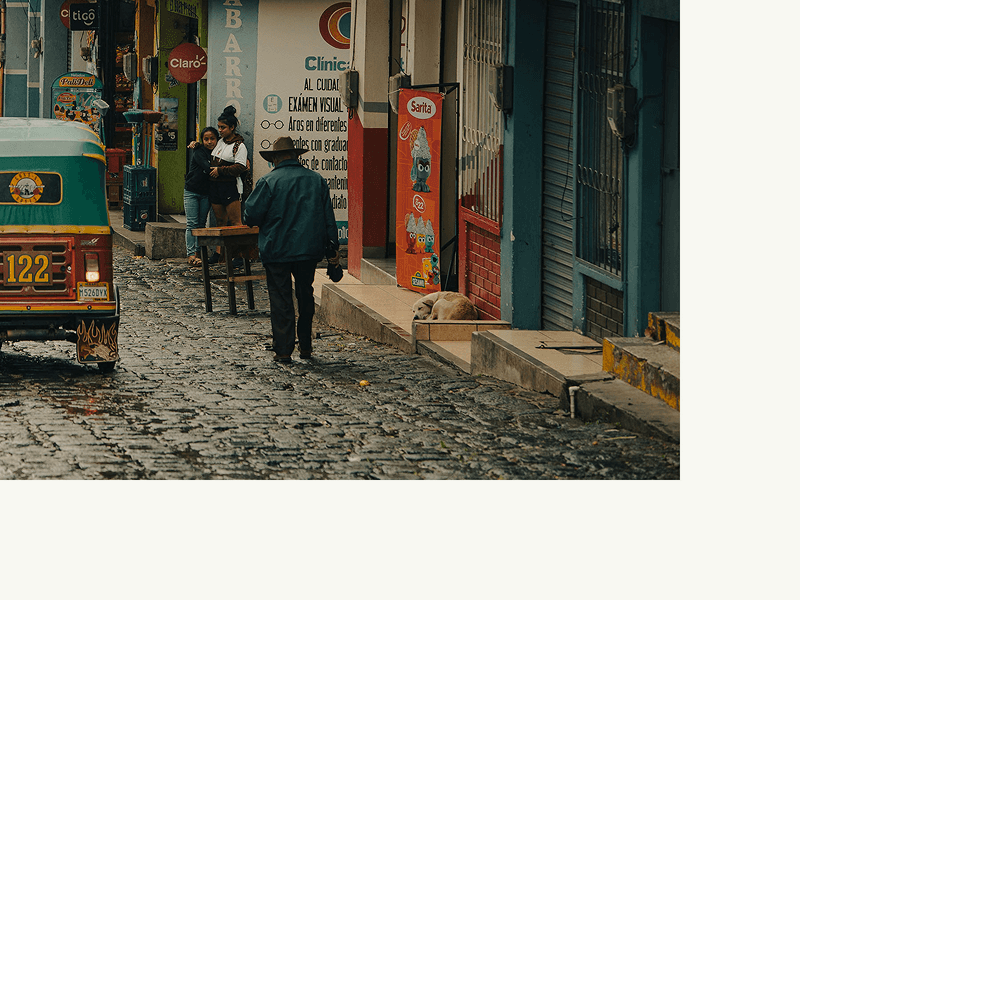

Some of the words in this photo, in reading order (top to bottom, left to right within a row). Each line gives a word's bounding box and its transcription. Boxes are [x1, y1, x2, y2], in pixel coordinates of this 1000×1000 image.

[170, 57, 201, 68] Claro
[304, 78, 314, 91] AL
[288, 93, 318, 113] EXÁMEN
[319, 96, 344, 113] VISUAL
[411, 100, 432, 114] Sarita
[288, 116, 304, 132] Aros
[305, 119, 314, 132] en
[315, 116, 348, 132] diferentes
[293, 136, 309, 151] entes
[310, 139, 322, 151] con
[323, 136, 349, 154] gradua
[310, 155, 320, 170] de
[321, 155, 348, 171] contacto
[6, 253, 50, 283] 122
